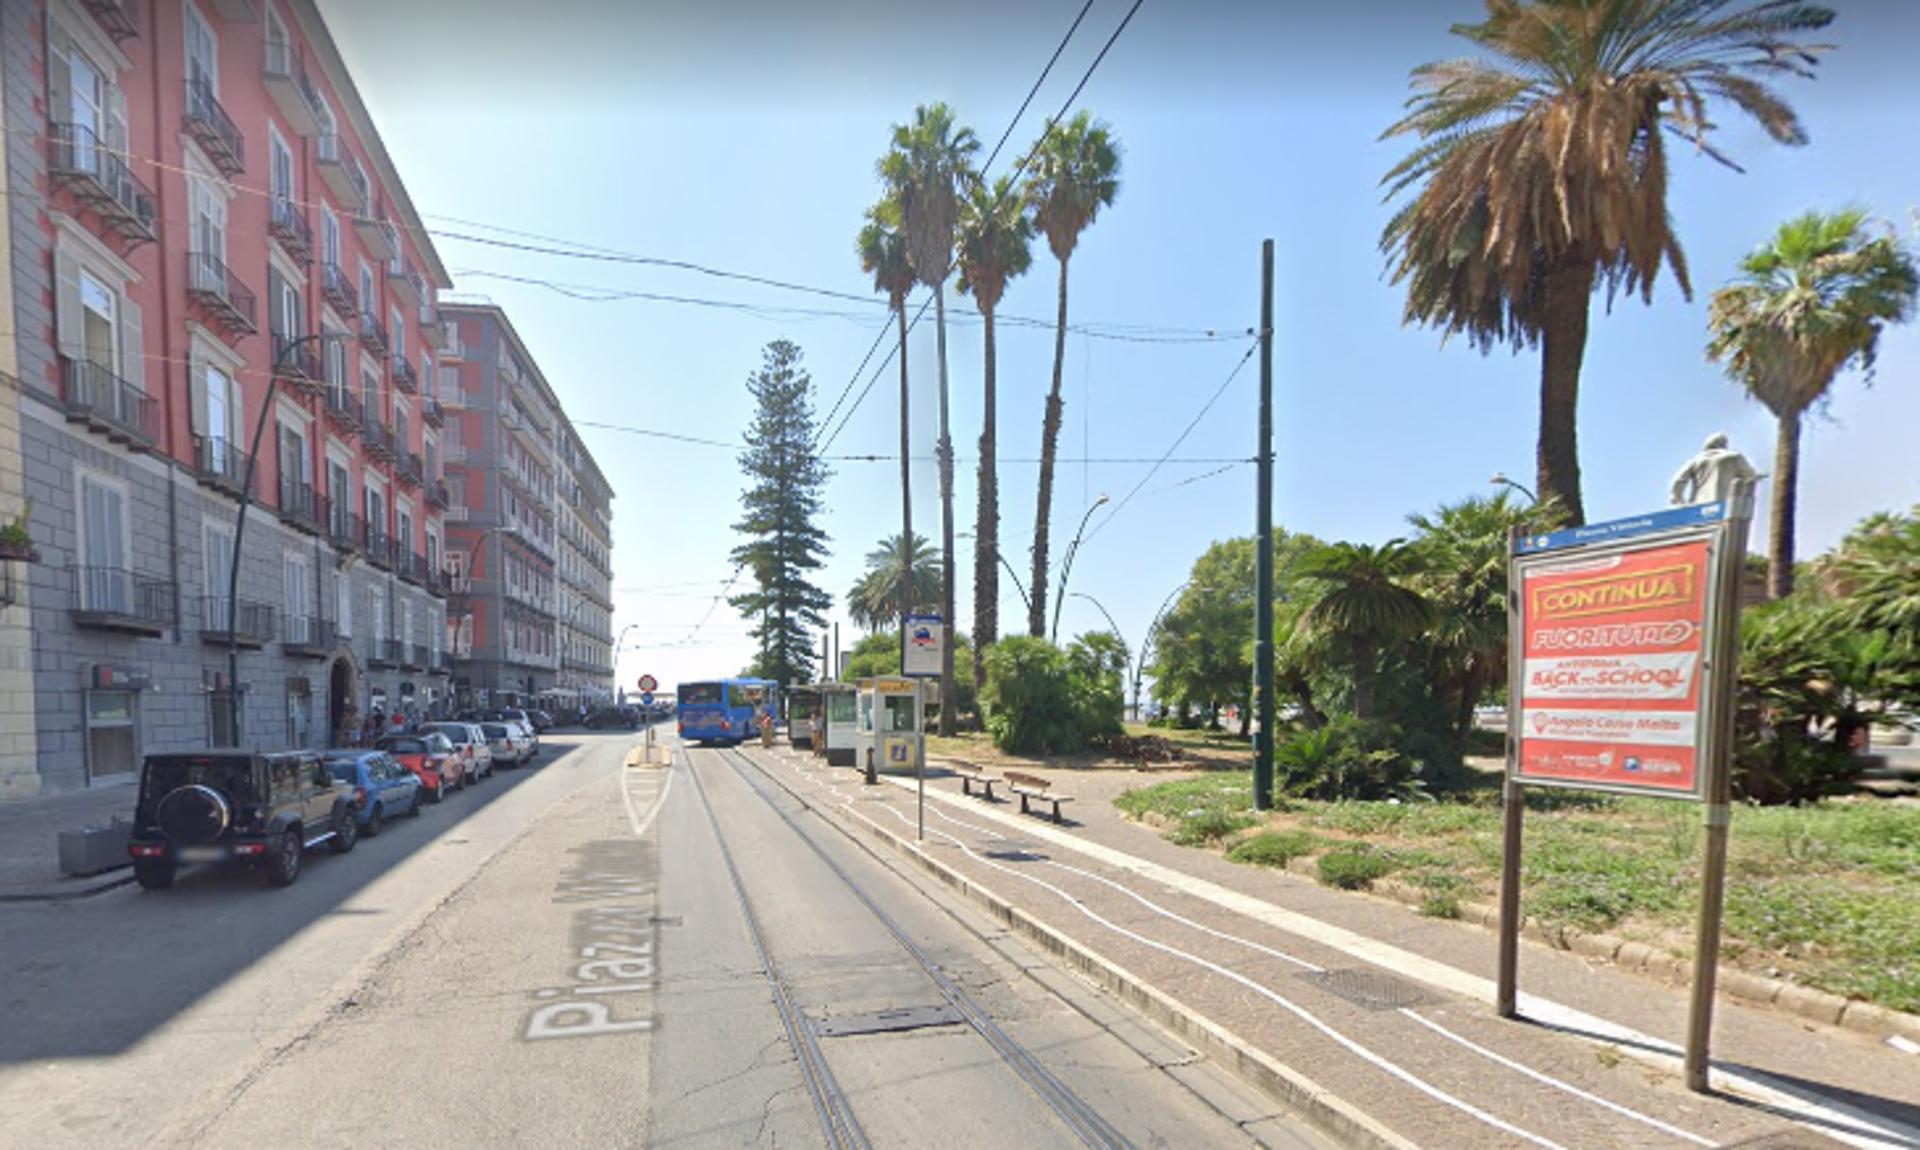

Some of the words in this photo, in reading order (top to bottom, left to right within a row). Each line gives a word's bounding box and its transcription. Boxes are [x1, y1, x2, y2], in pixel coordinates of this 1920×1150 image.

[1545, 578, 1677, 611] CONTINUA
[1531, 669, 1580, 686] BACK
[1597, 668, 1686, 687] SCHOOL
